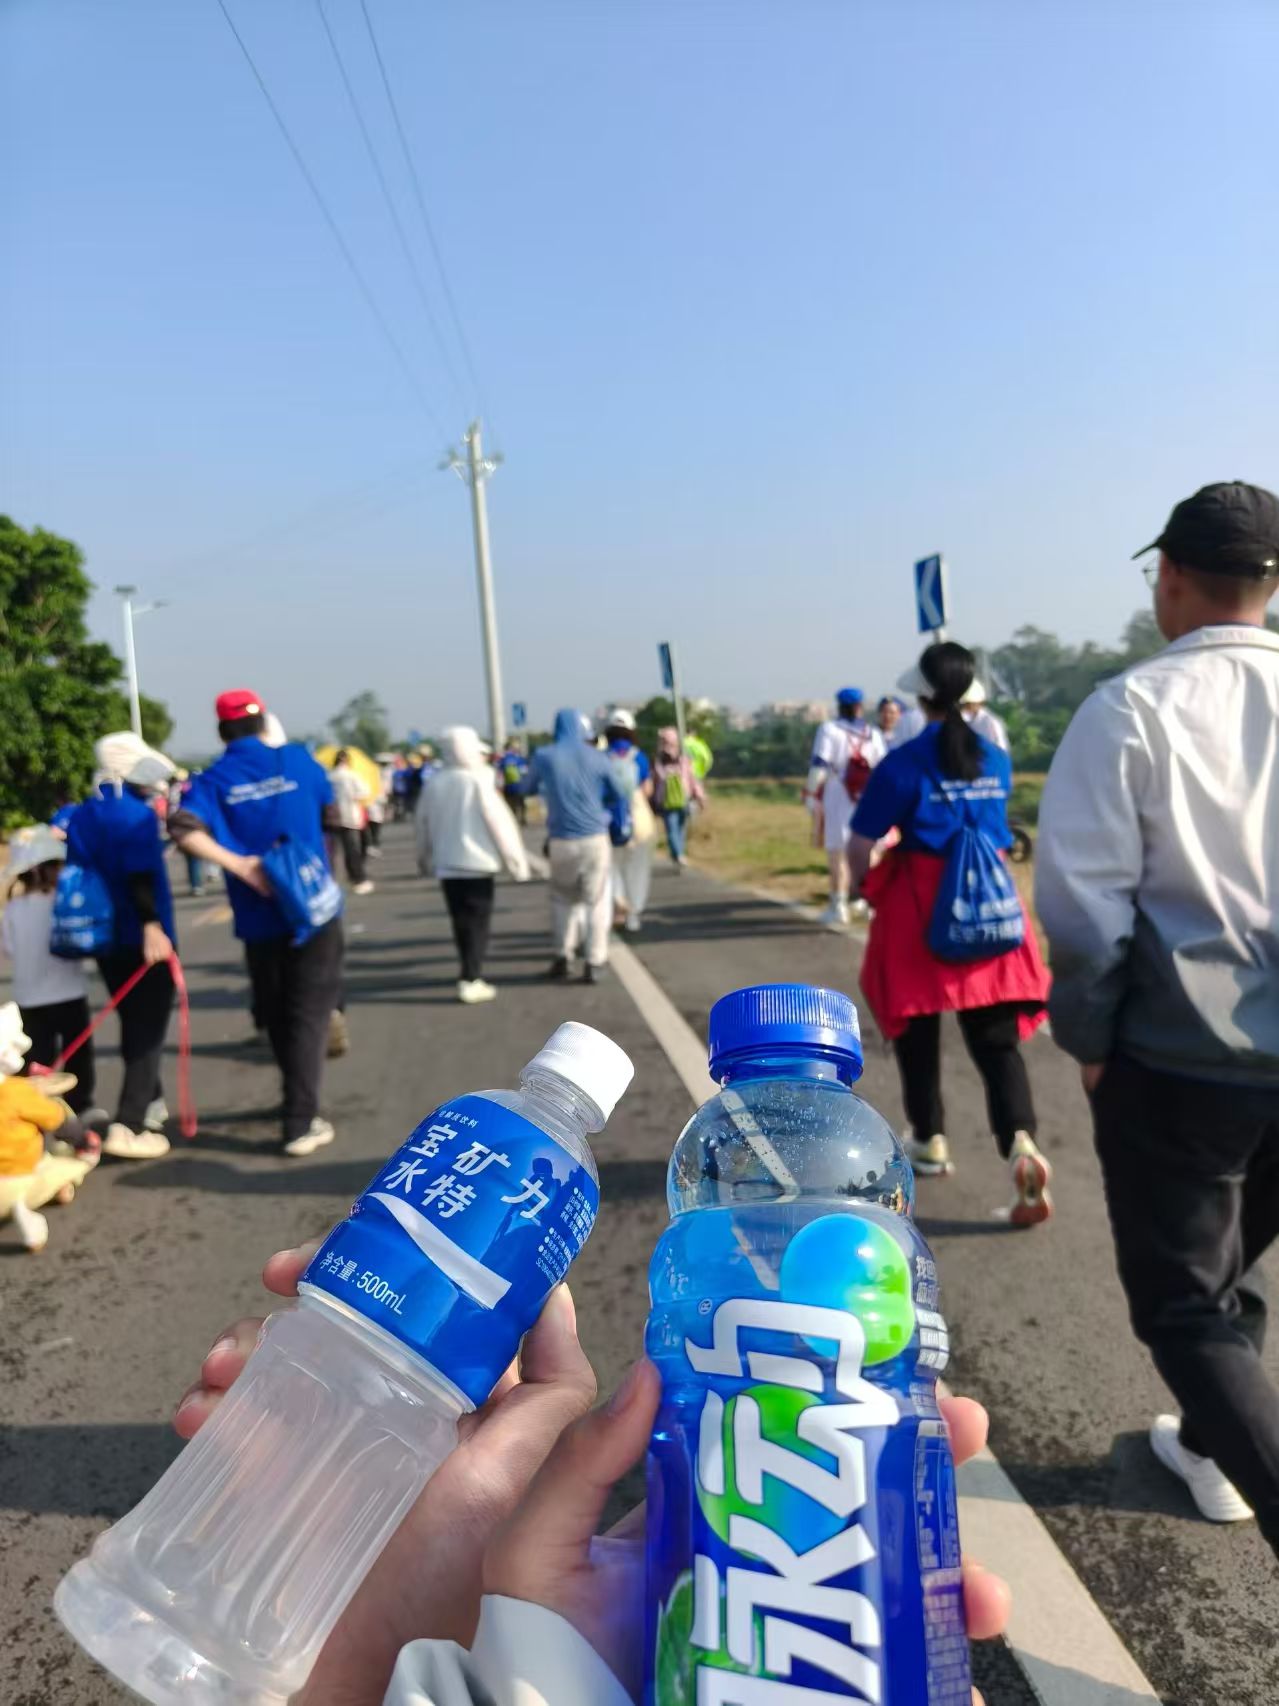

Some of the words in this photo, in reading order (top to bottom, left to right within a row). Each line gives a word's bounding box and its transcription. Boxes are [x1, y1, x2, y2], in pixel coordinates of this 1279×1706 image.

[385, 1158, 478, 1220] 水特
[409, 1124, 550, 1220] 宝矿力
[685, 1297, 900, 1706] 脉动
